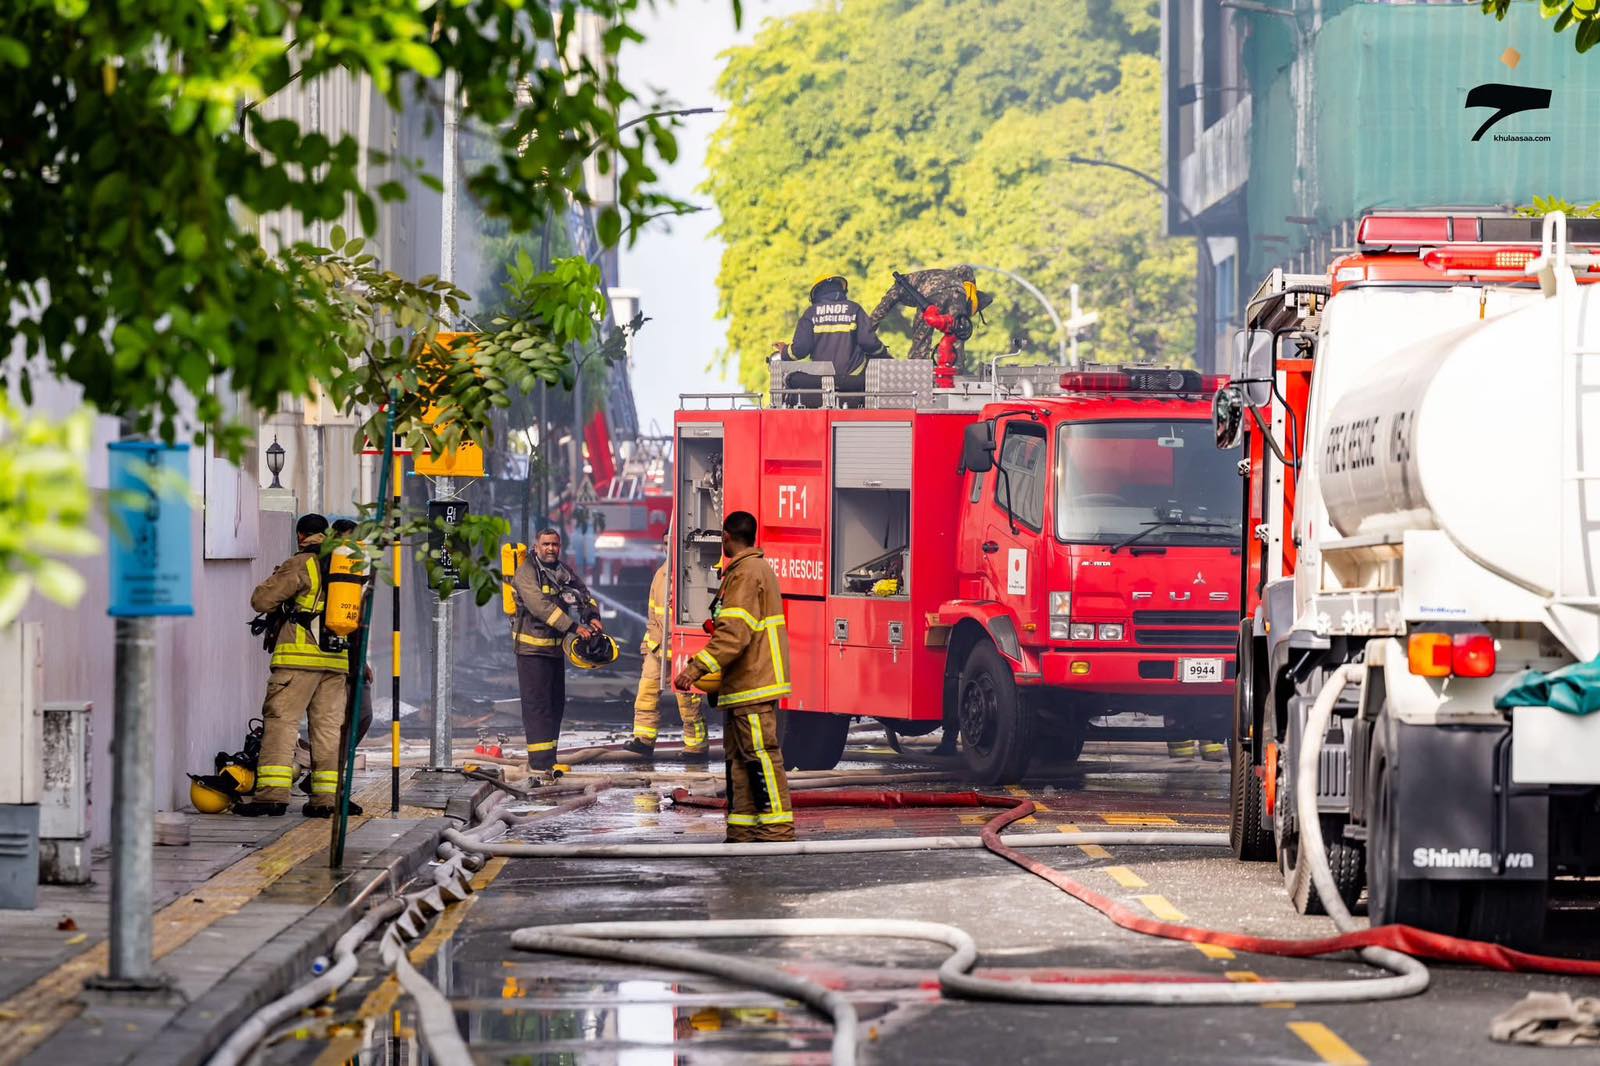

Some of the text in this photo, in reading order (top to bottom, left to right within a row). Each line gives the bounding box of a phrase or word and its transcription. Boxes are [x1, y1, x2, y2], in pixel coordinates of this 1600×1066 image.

[778, 484, 807, 520] FT-1
[768, 557, 824, 580] RE & RESCUE
[1132, 591, 1230, 601] FUS
[1190, 665, 1216, 675] 9944
[1413, 847, 1535, 870] ShinMawa
